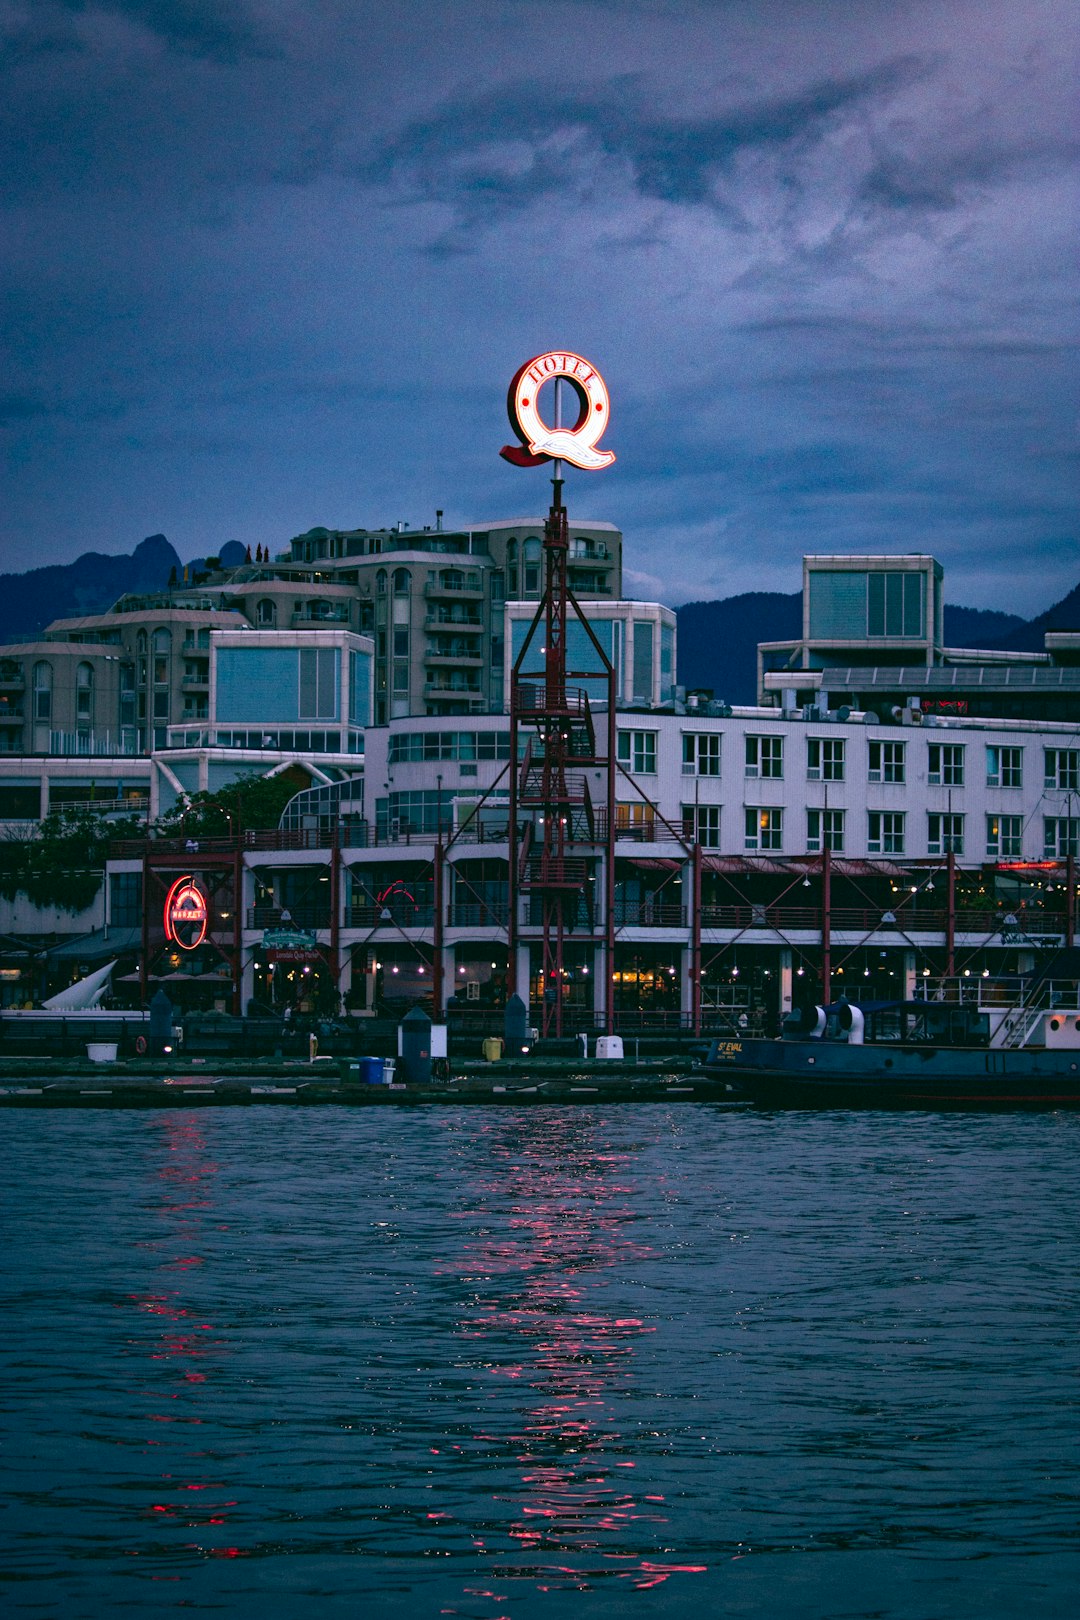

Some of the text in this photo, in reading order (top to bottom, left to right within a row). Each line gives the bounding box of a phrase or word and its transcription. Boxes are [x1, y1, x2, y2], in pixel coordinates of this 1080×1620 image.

[528, 356, 595, 389] HOTEL
[500, 350, 617, 470] Q
[172, 910, 202, 919] MARKET
